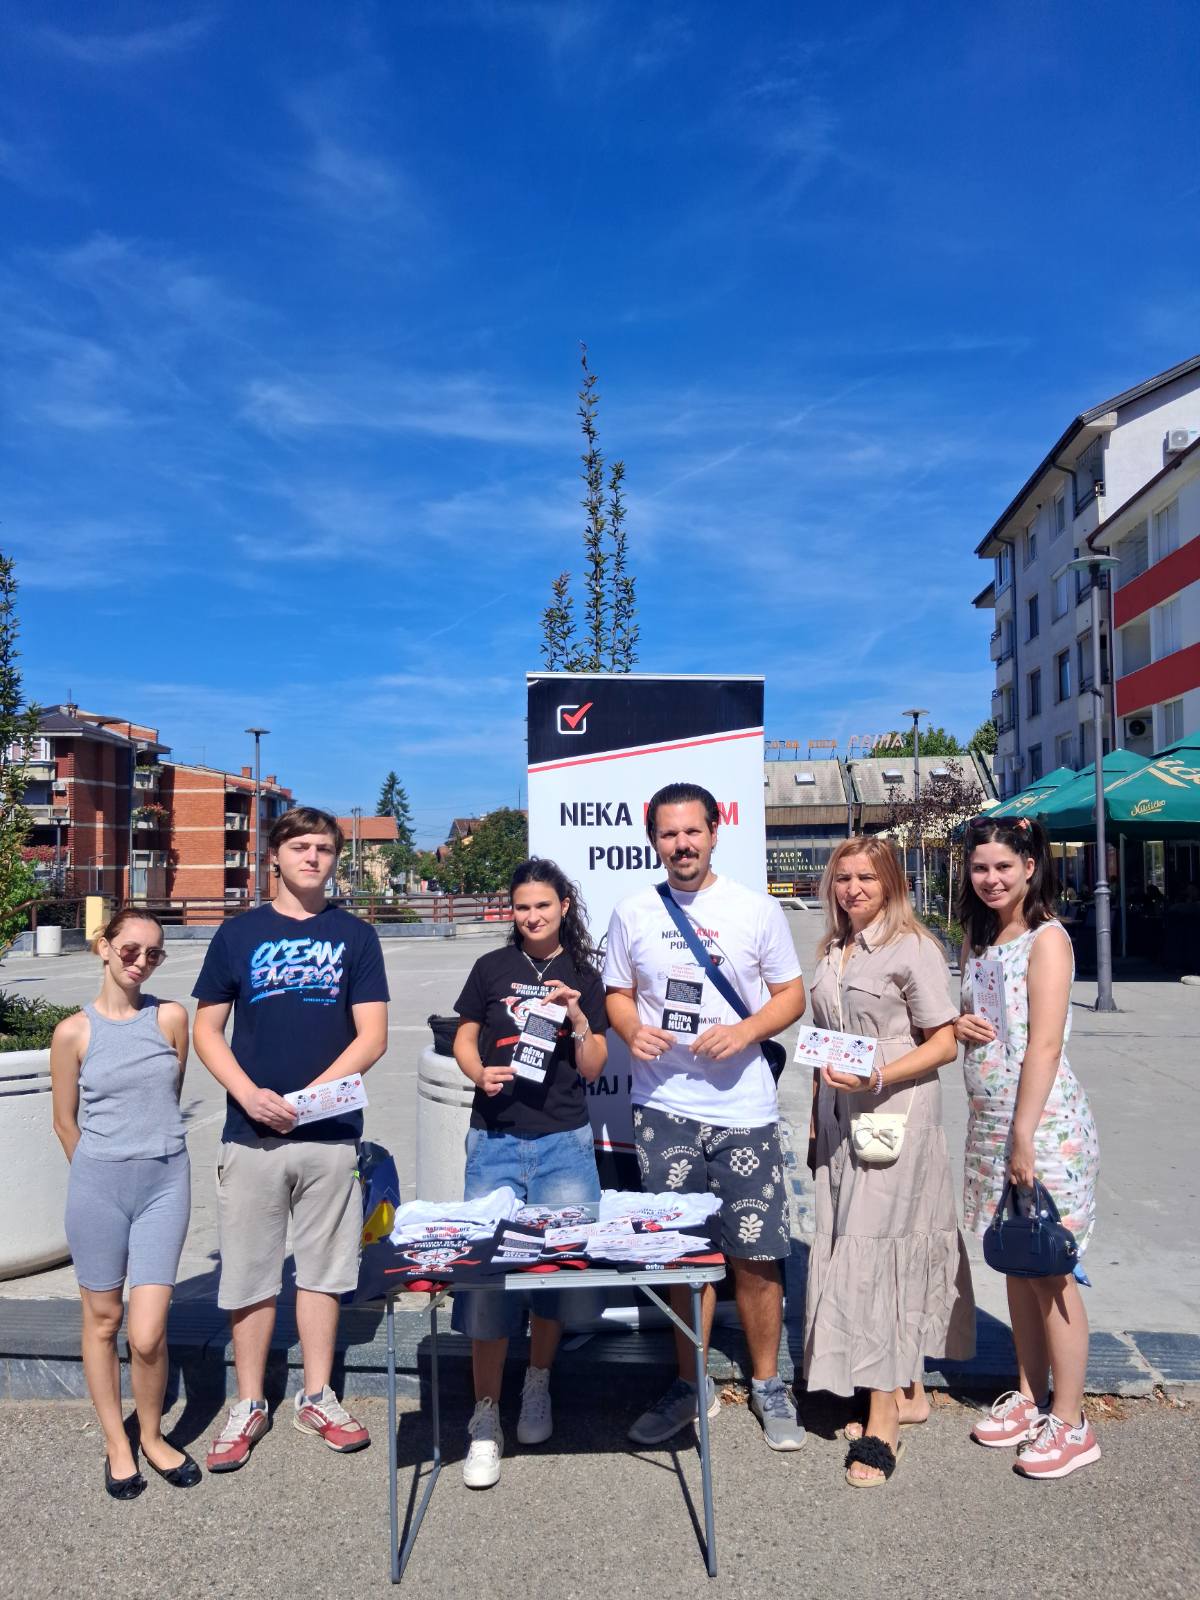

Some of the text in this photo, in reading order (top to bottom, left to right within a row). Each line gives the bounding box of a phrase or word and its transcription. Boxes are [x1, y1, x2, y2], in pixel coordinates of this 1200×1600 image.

[560, 801, 632, 826] NEKA
[251, 938, 345, 968] OCEAN
[250, 964, 344, 988] ENERGY
[668, 1012, 692, 1023] OŠTRA
[667, 1020, 692, 1032] NULA
[520, 1053, 543, 1067] NULA
[522, 1046, 545, 1060] OŠTRA
